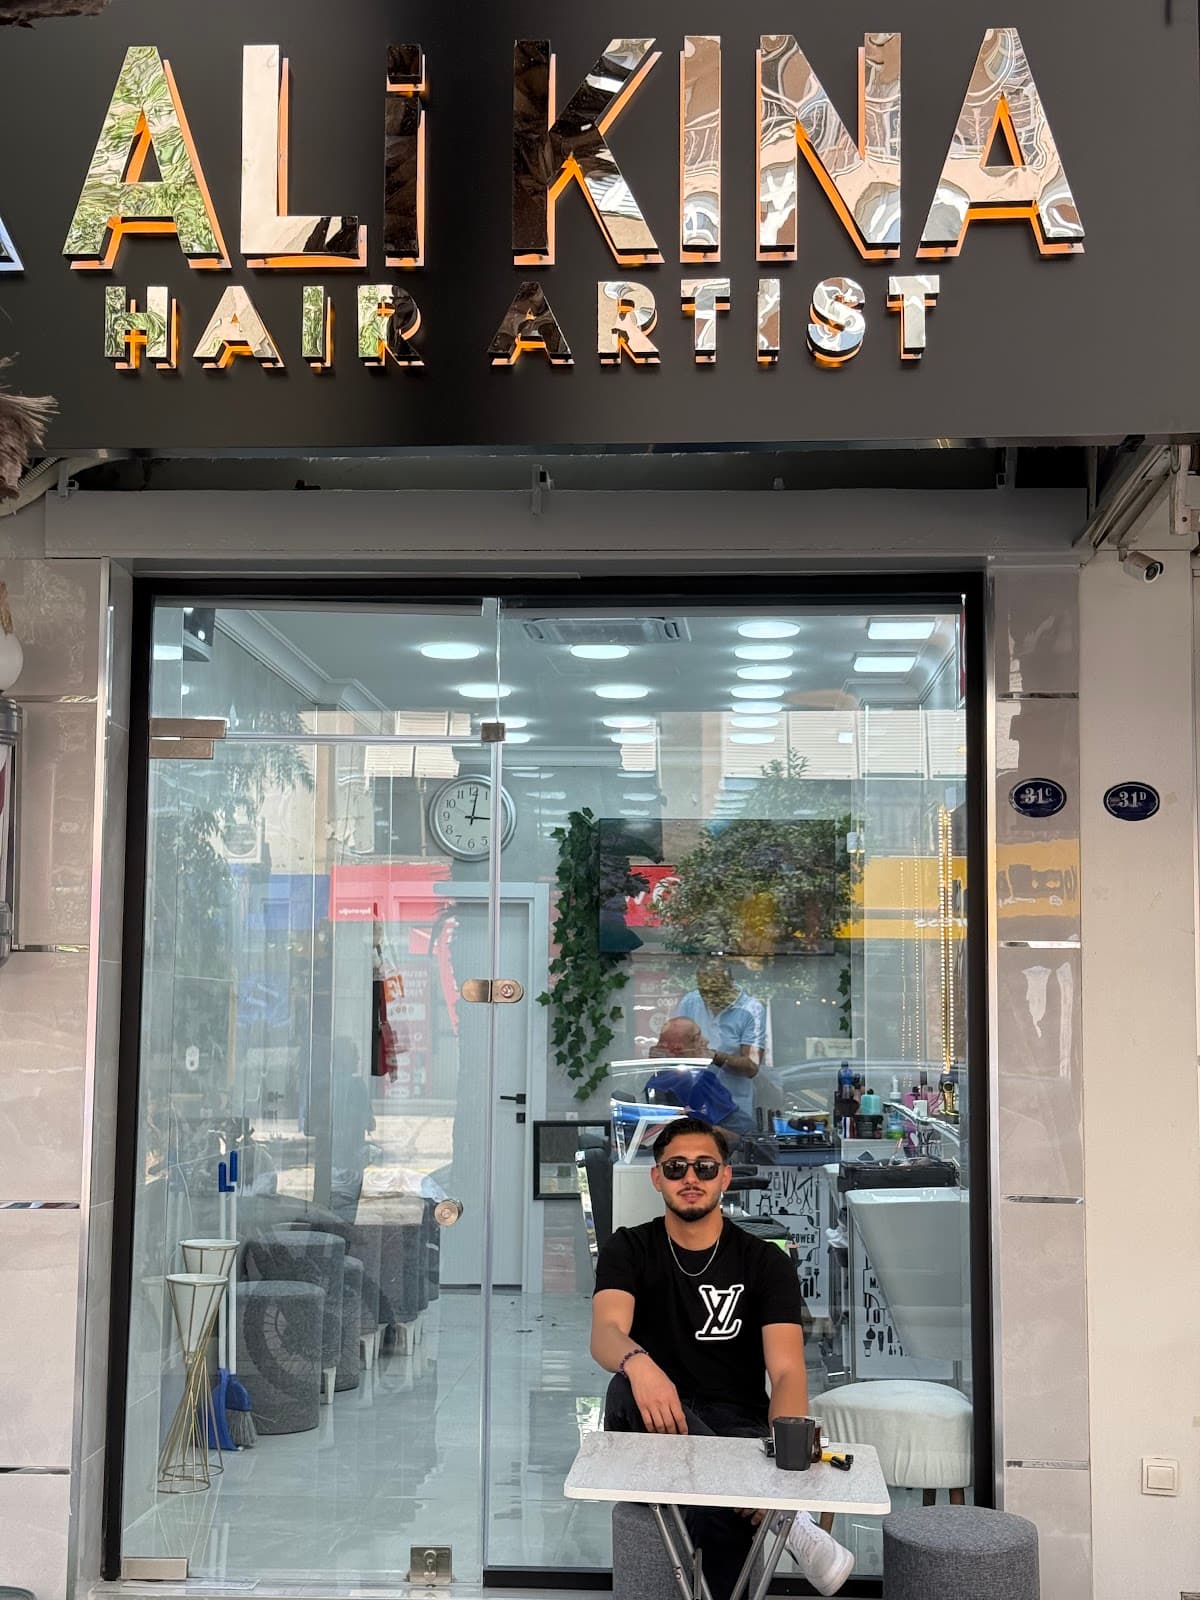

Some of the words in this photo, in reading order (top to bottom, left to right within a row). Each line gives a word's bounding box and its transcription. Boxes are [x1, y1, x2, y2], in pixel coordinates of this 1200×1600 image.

[512, 28, 1085, 266] KINA
[104, 284, 426, 370] HAIR
[487, 275, 941, 369] ARTIST
